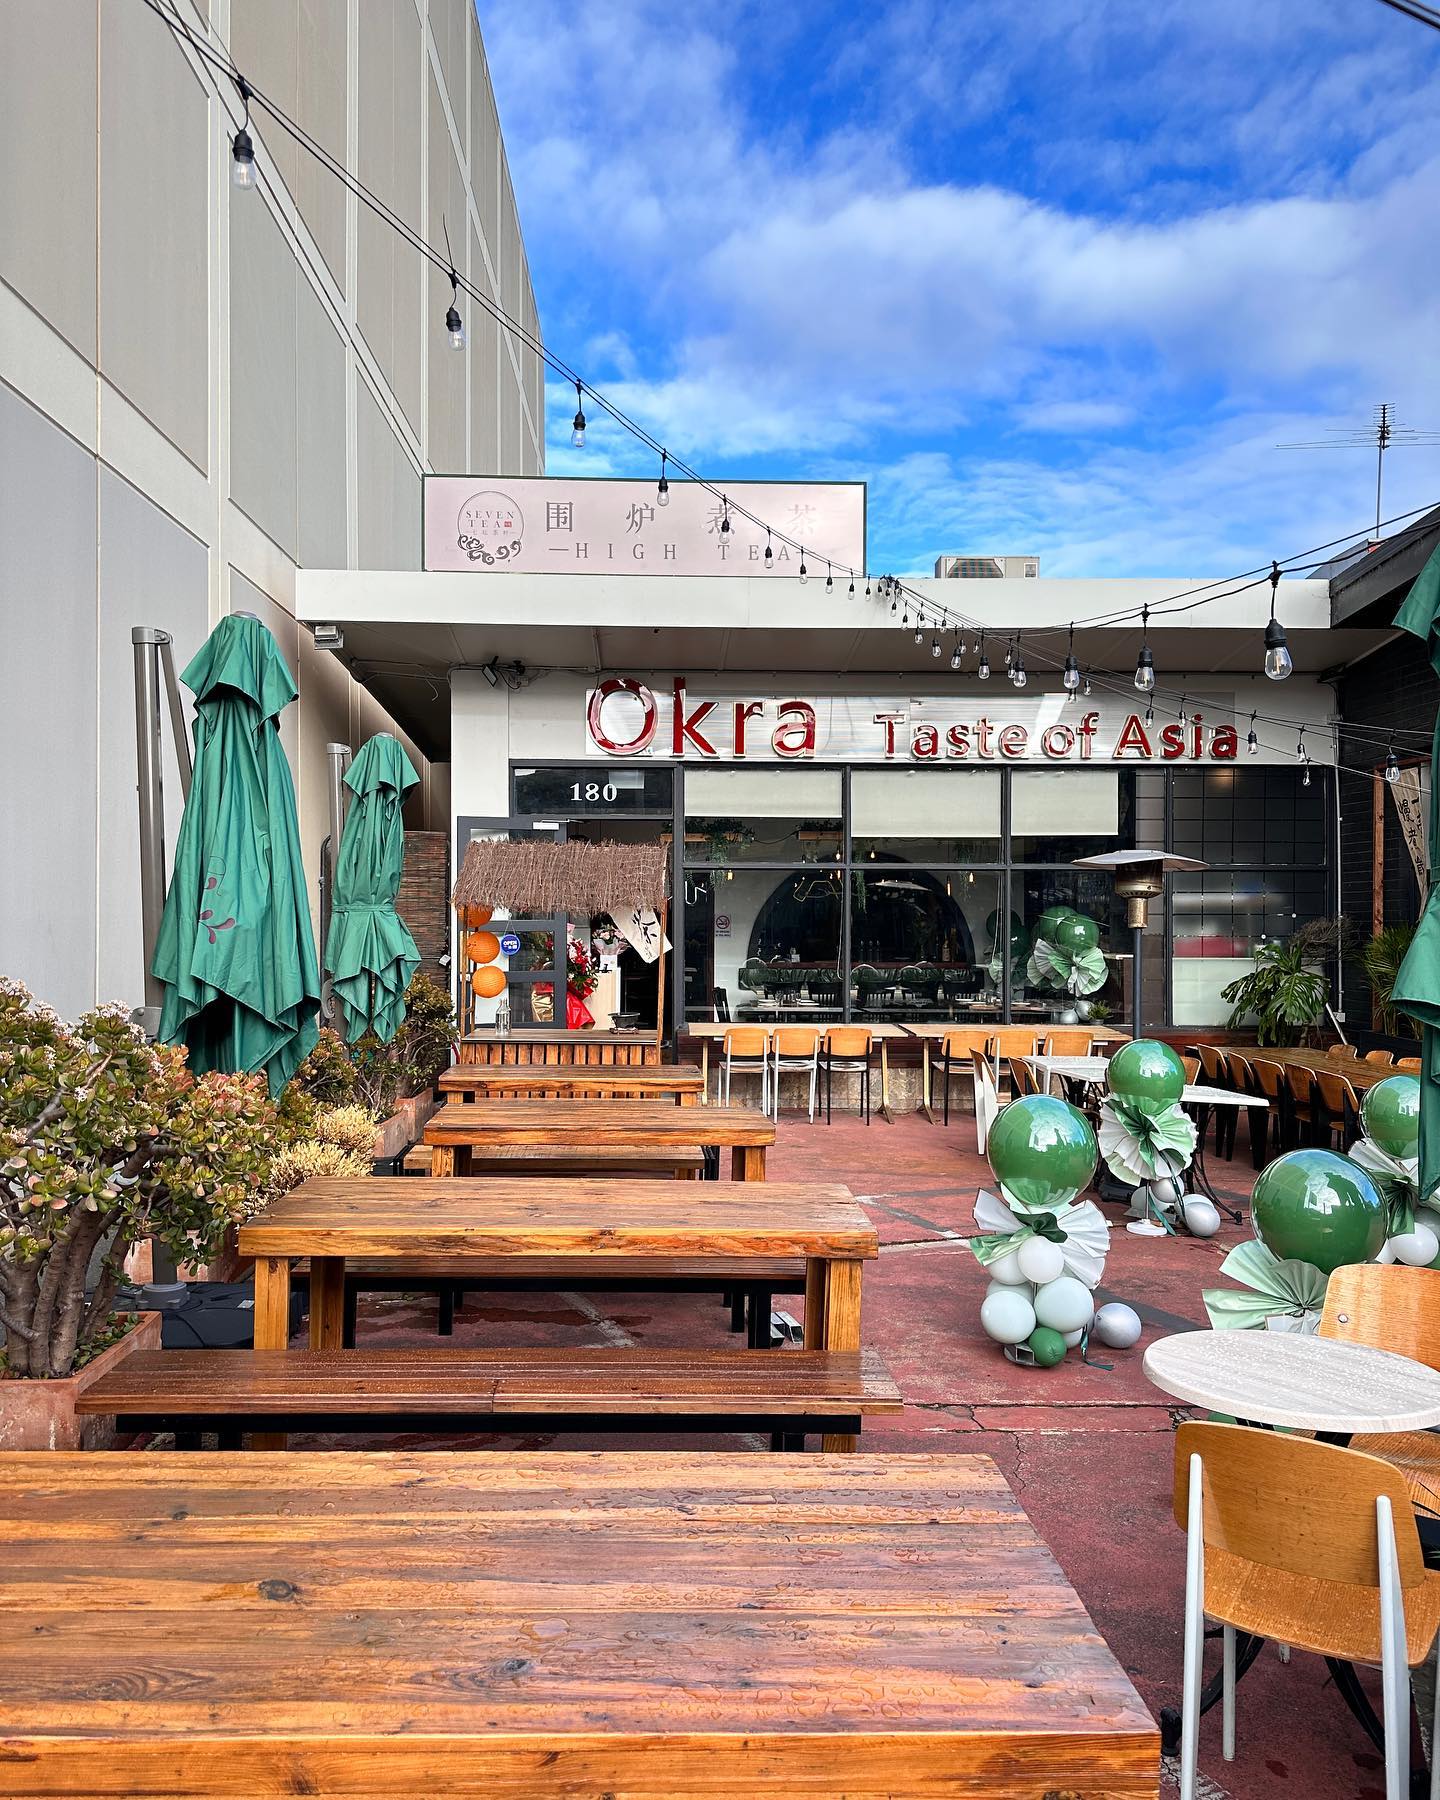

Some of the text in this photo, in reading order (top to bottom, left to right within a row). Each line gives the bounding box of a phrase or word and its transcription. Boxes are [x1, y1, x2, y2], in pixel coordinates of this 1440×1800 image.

[466, 510, 514, 519] SEVEN
[468, 519, 501, 528] TEA
[546, 501, 817, 536] 围炉煮茶
[587, 677, 1239, 759] Okra Taste of Asia
[569, 782, 618, 802] 180
